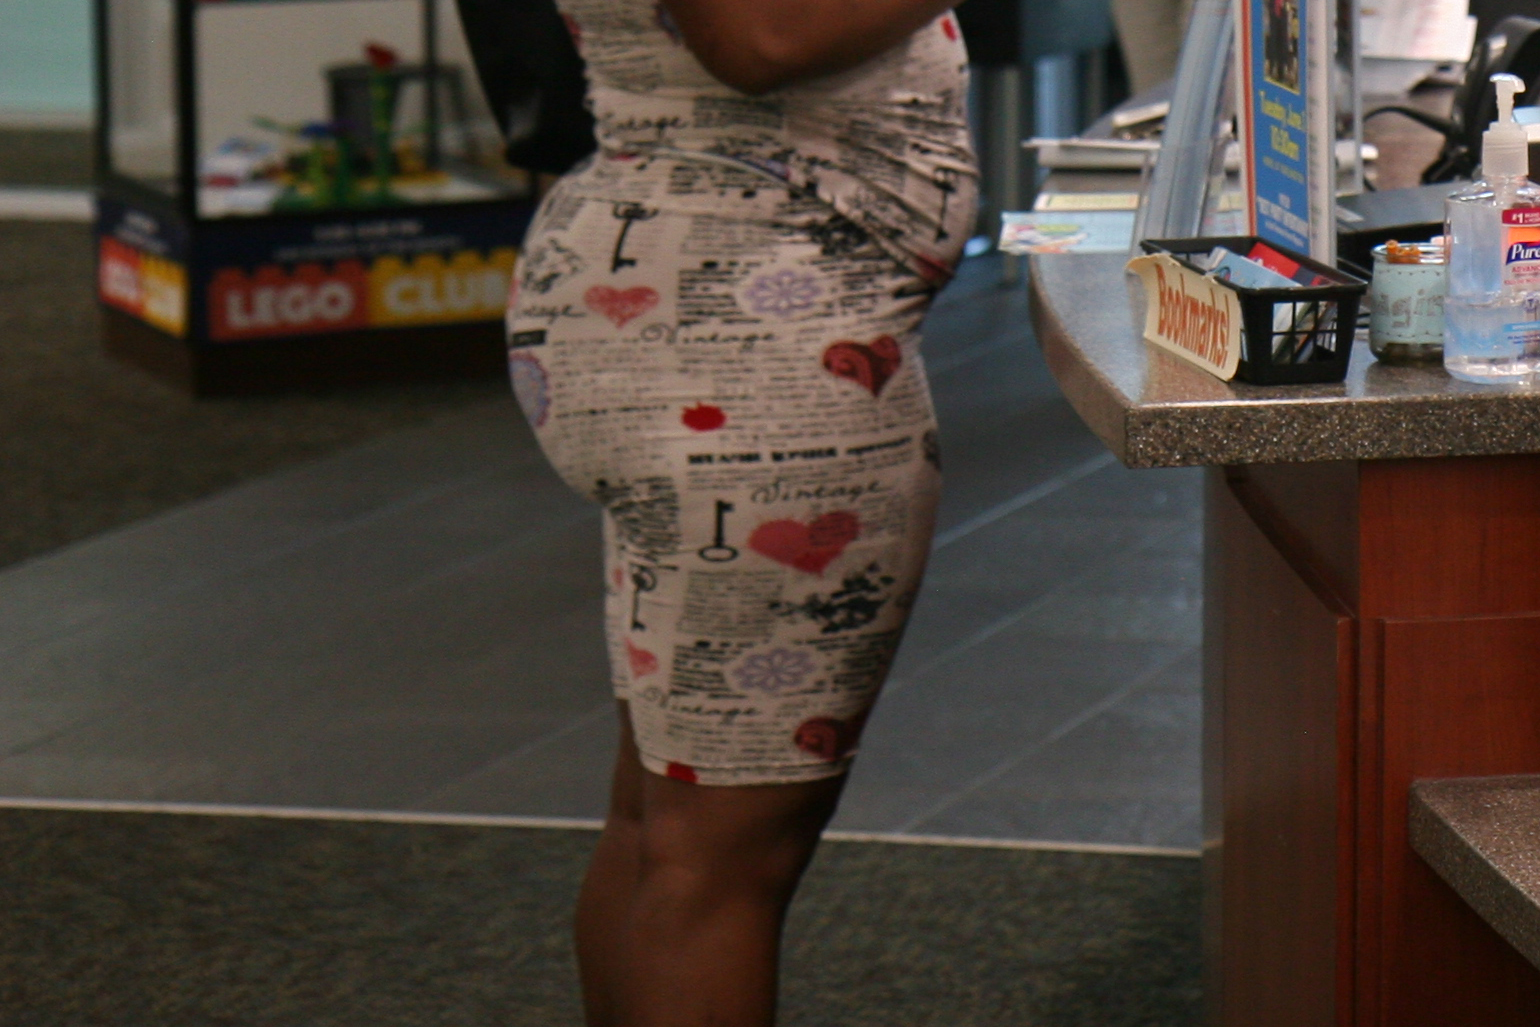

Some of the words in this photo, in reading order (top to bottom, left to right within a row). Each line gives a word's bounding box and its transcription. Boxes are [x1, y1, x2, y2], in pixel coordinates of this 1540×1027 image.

[225, 279, 356, 331] LEGO
[383, 270, 509, 315] CLUB
[1154, 261, 1230, 369] Bookmarks!
